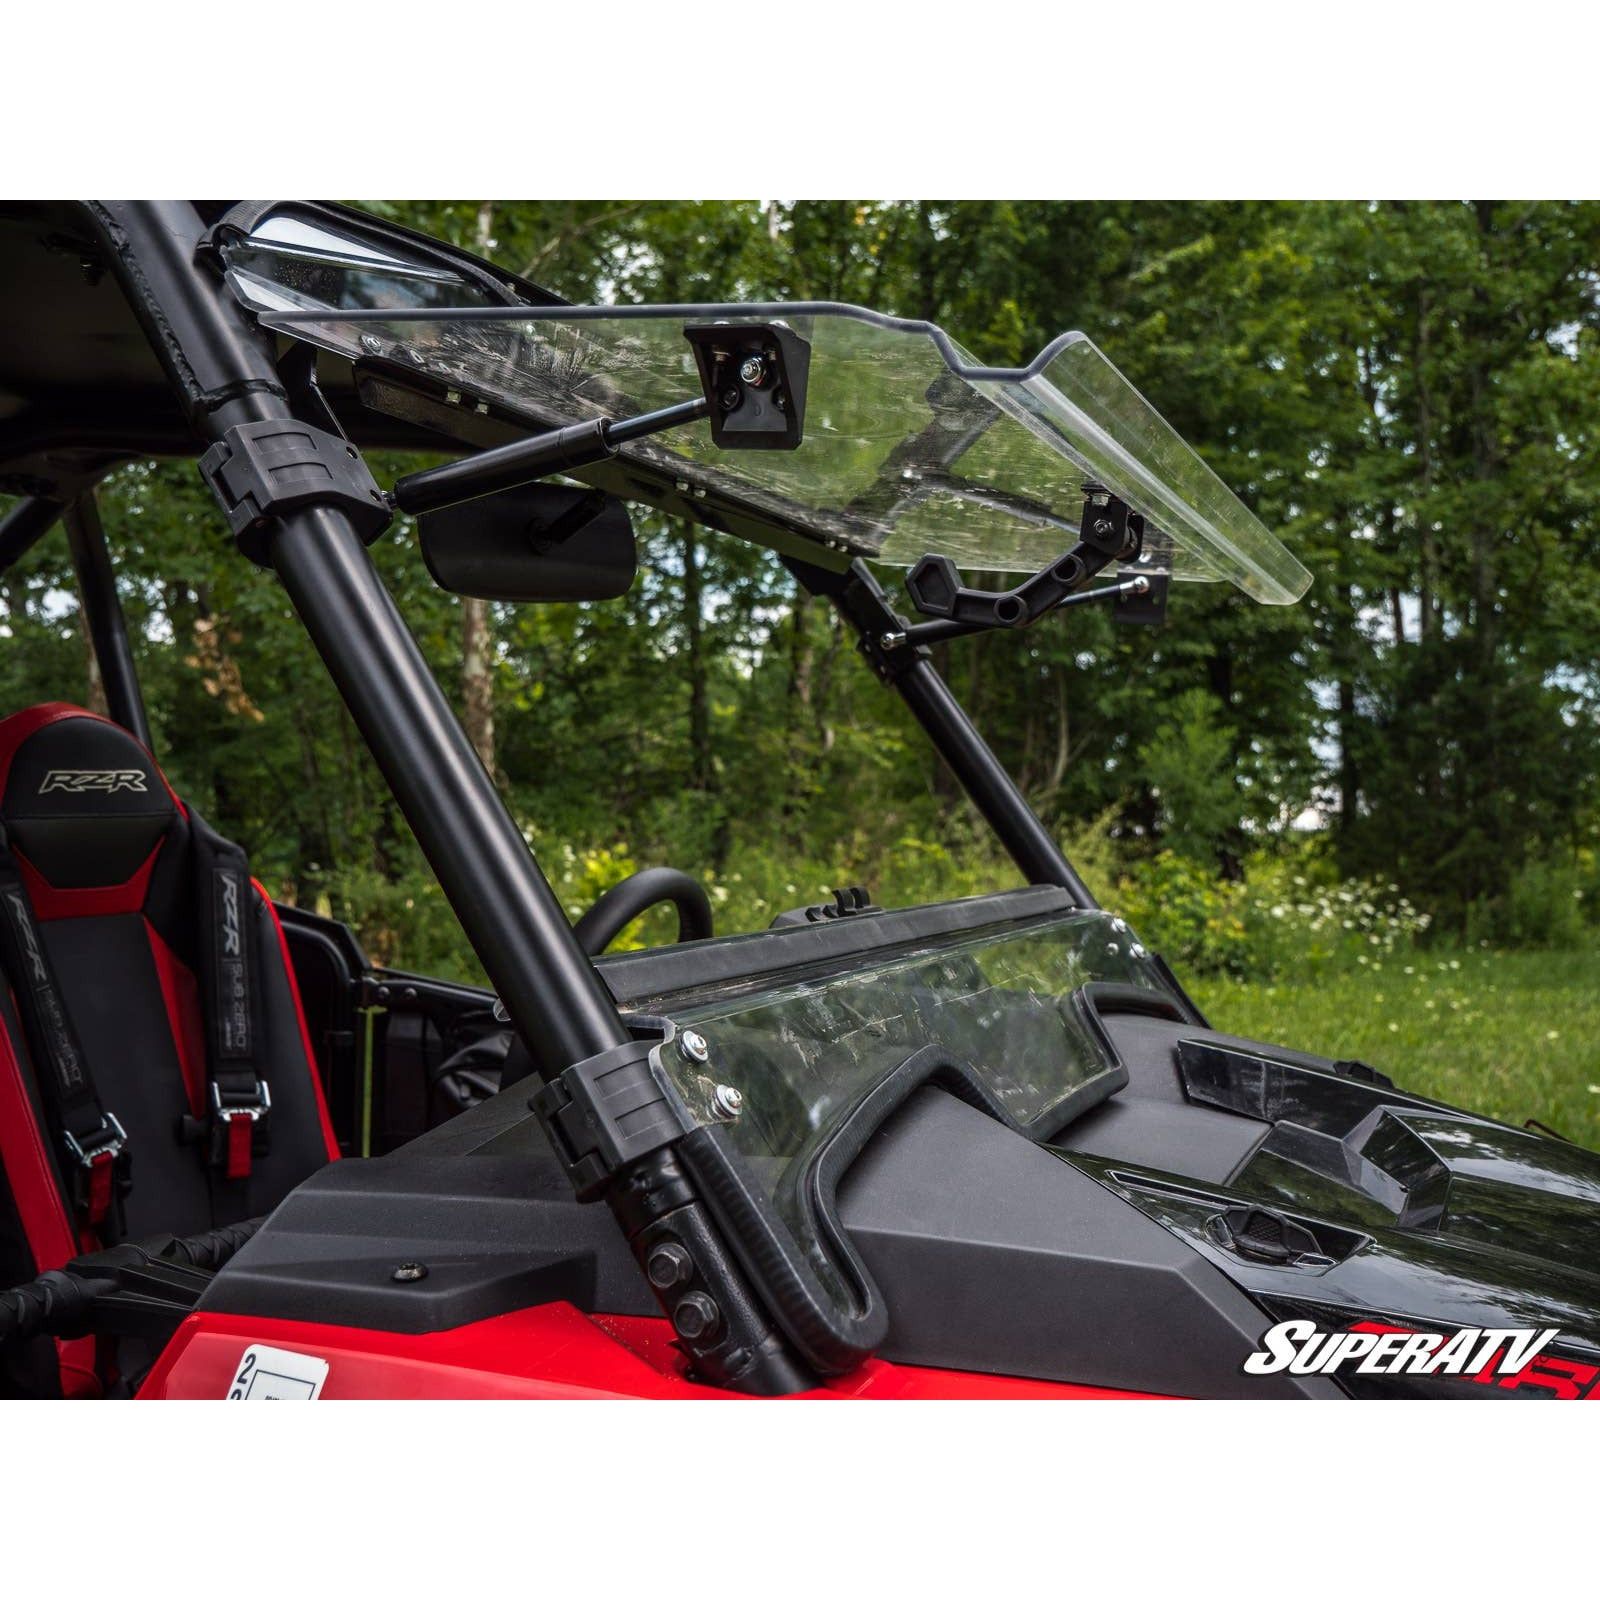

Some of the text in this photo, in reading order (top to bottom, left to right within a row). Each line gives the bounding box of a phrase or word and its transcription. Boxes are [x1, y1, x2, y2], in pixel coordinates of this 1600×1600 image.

[38, 769, 148, 794] RZR
[7, 893, 47, 982] RZR
[221, 875, 240, 956] RZR
